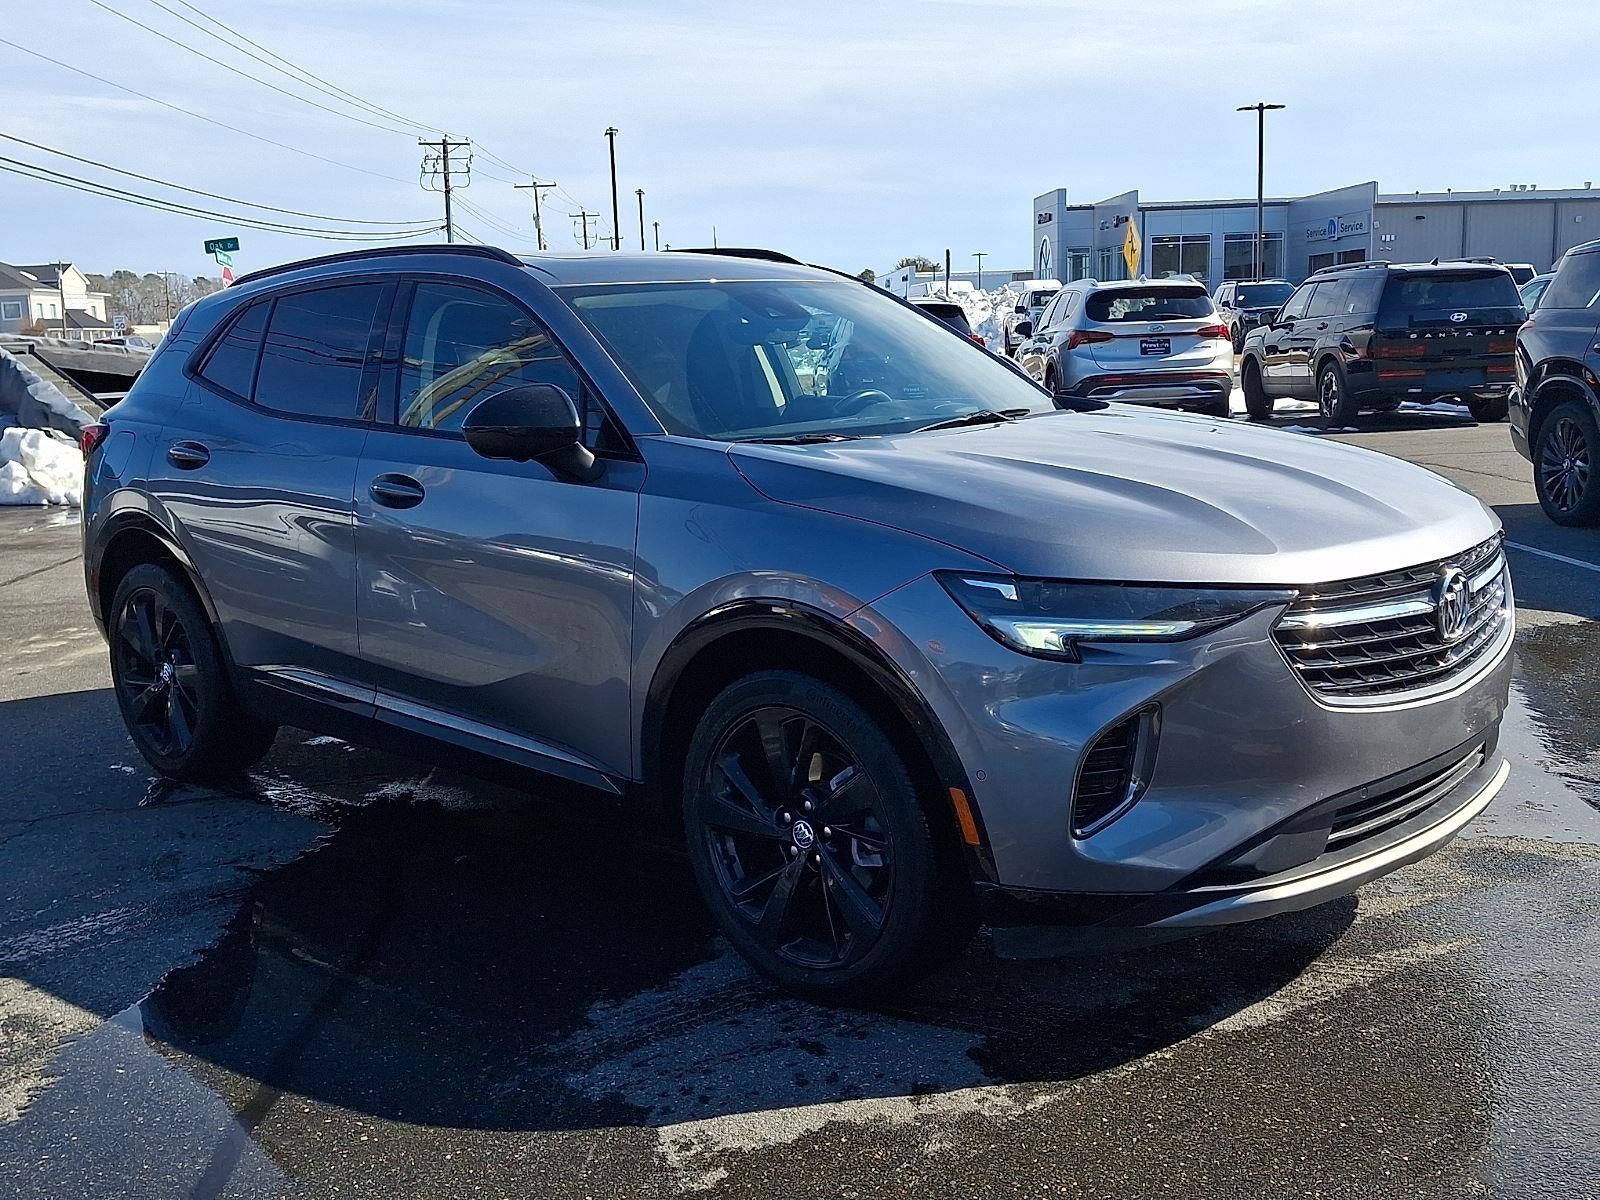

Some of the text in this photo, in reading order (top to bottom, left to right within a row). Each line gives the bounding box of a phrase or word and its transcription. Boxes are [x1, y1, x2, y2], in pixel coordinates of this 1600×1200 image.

[1306, 222, 1363, 238] Service Service
[209, 241, 224, 251] Oak
[1410, 331, 1474, 339] SANTA
